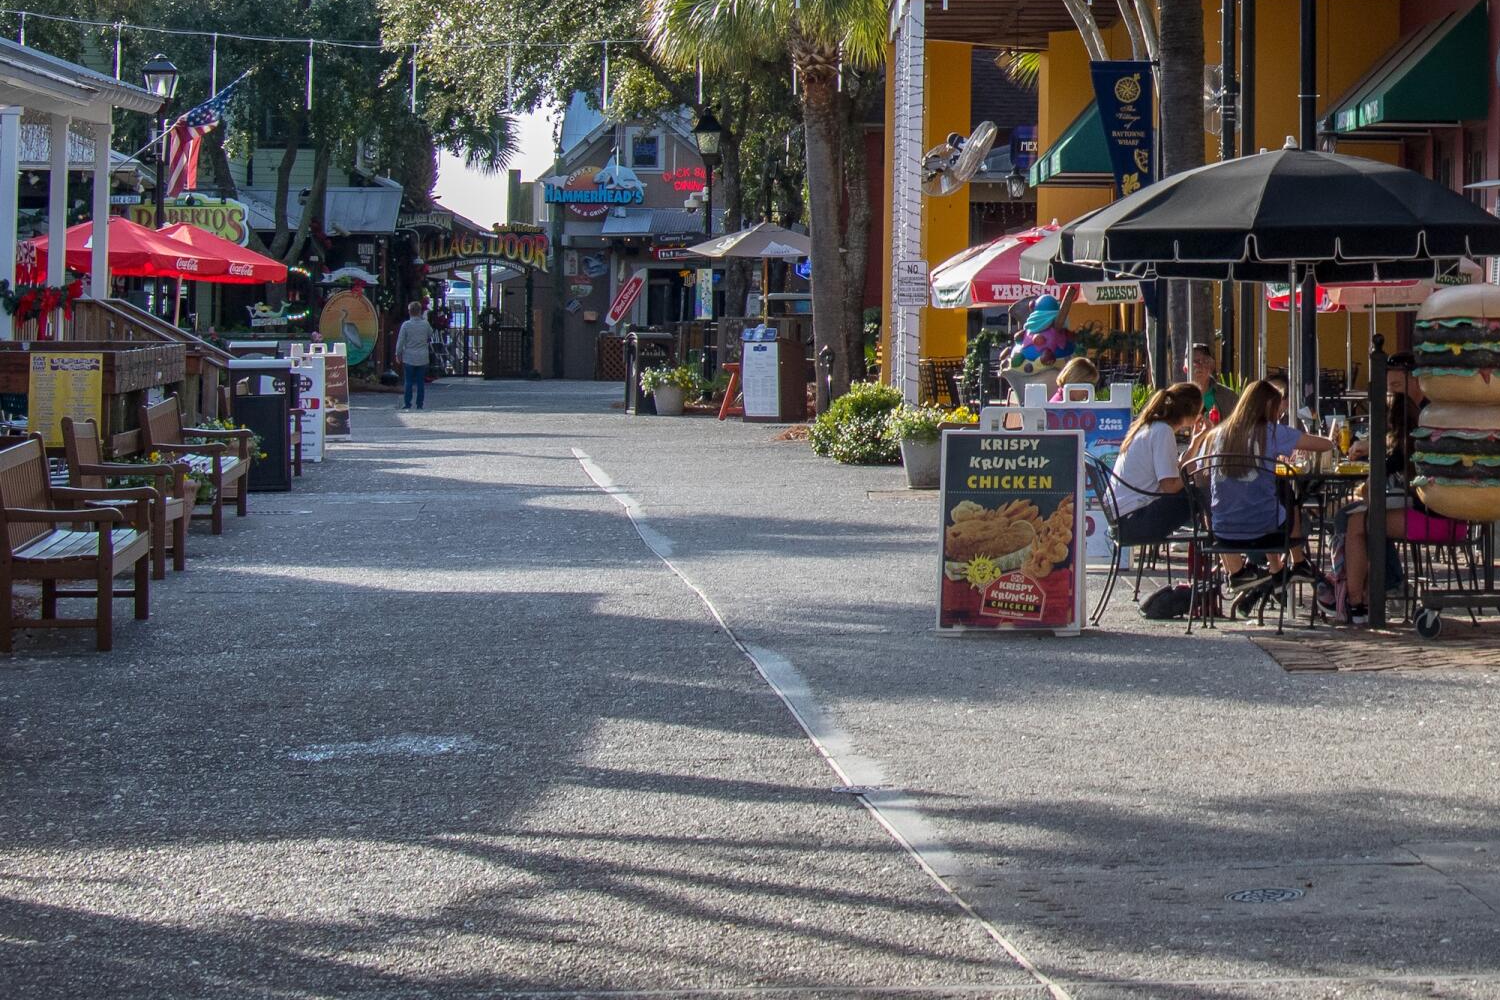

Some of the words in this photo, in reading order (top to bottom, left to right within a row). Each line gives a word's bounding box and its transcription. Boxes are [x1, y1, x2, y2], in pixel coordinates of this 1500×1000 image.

[487, 233, 549, 273] DOOR
[907, 264, 919, 274] NO
[991, 284, 1061, 300] TABASCO
[1096, 285, 1138, 300] TABASCO
[981, 439, 1040, 451] KRISPY
[969, 456, 1051, 471] KRUNCHY
[967, 475, 1052, 489] CHICKEN
[999, 581, 1035, 592] KRISPY
[991, 601, 1035, 611] CHICKEN
